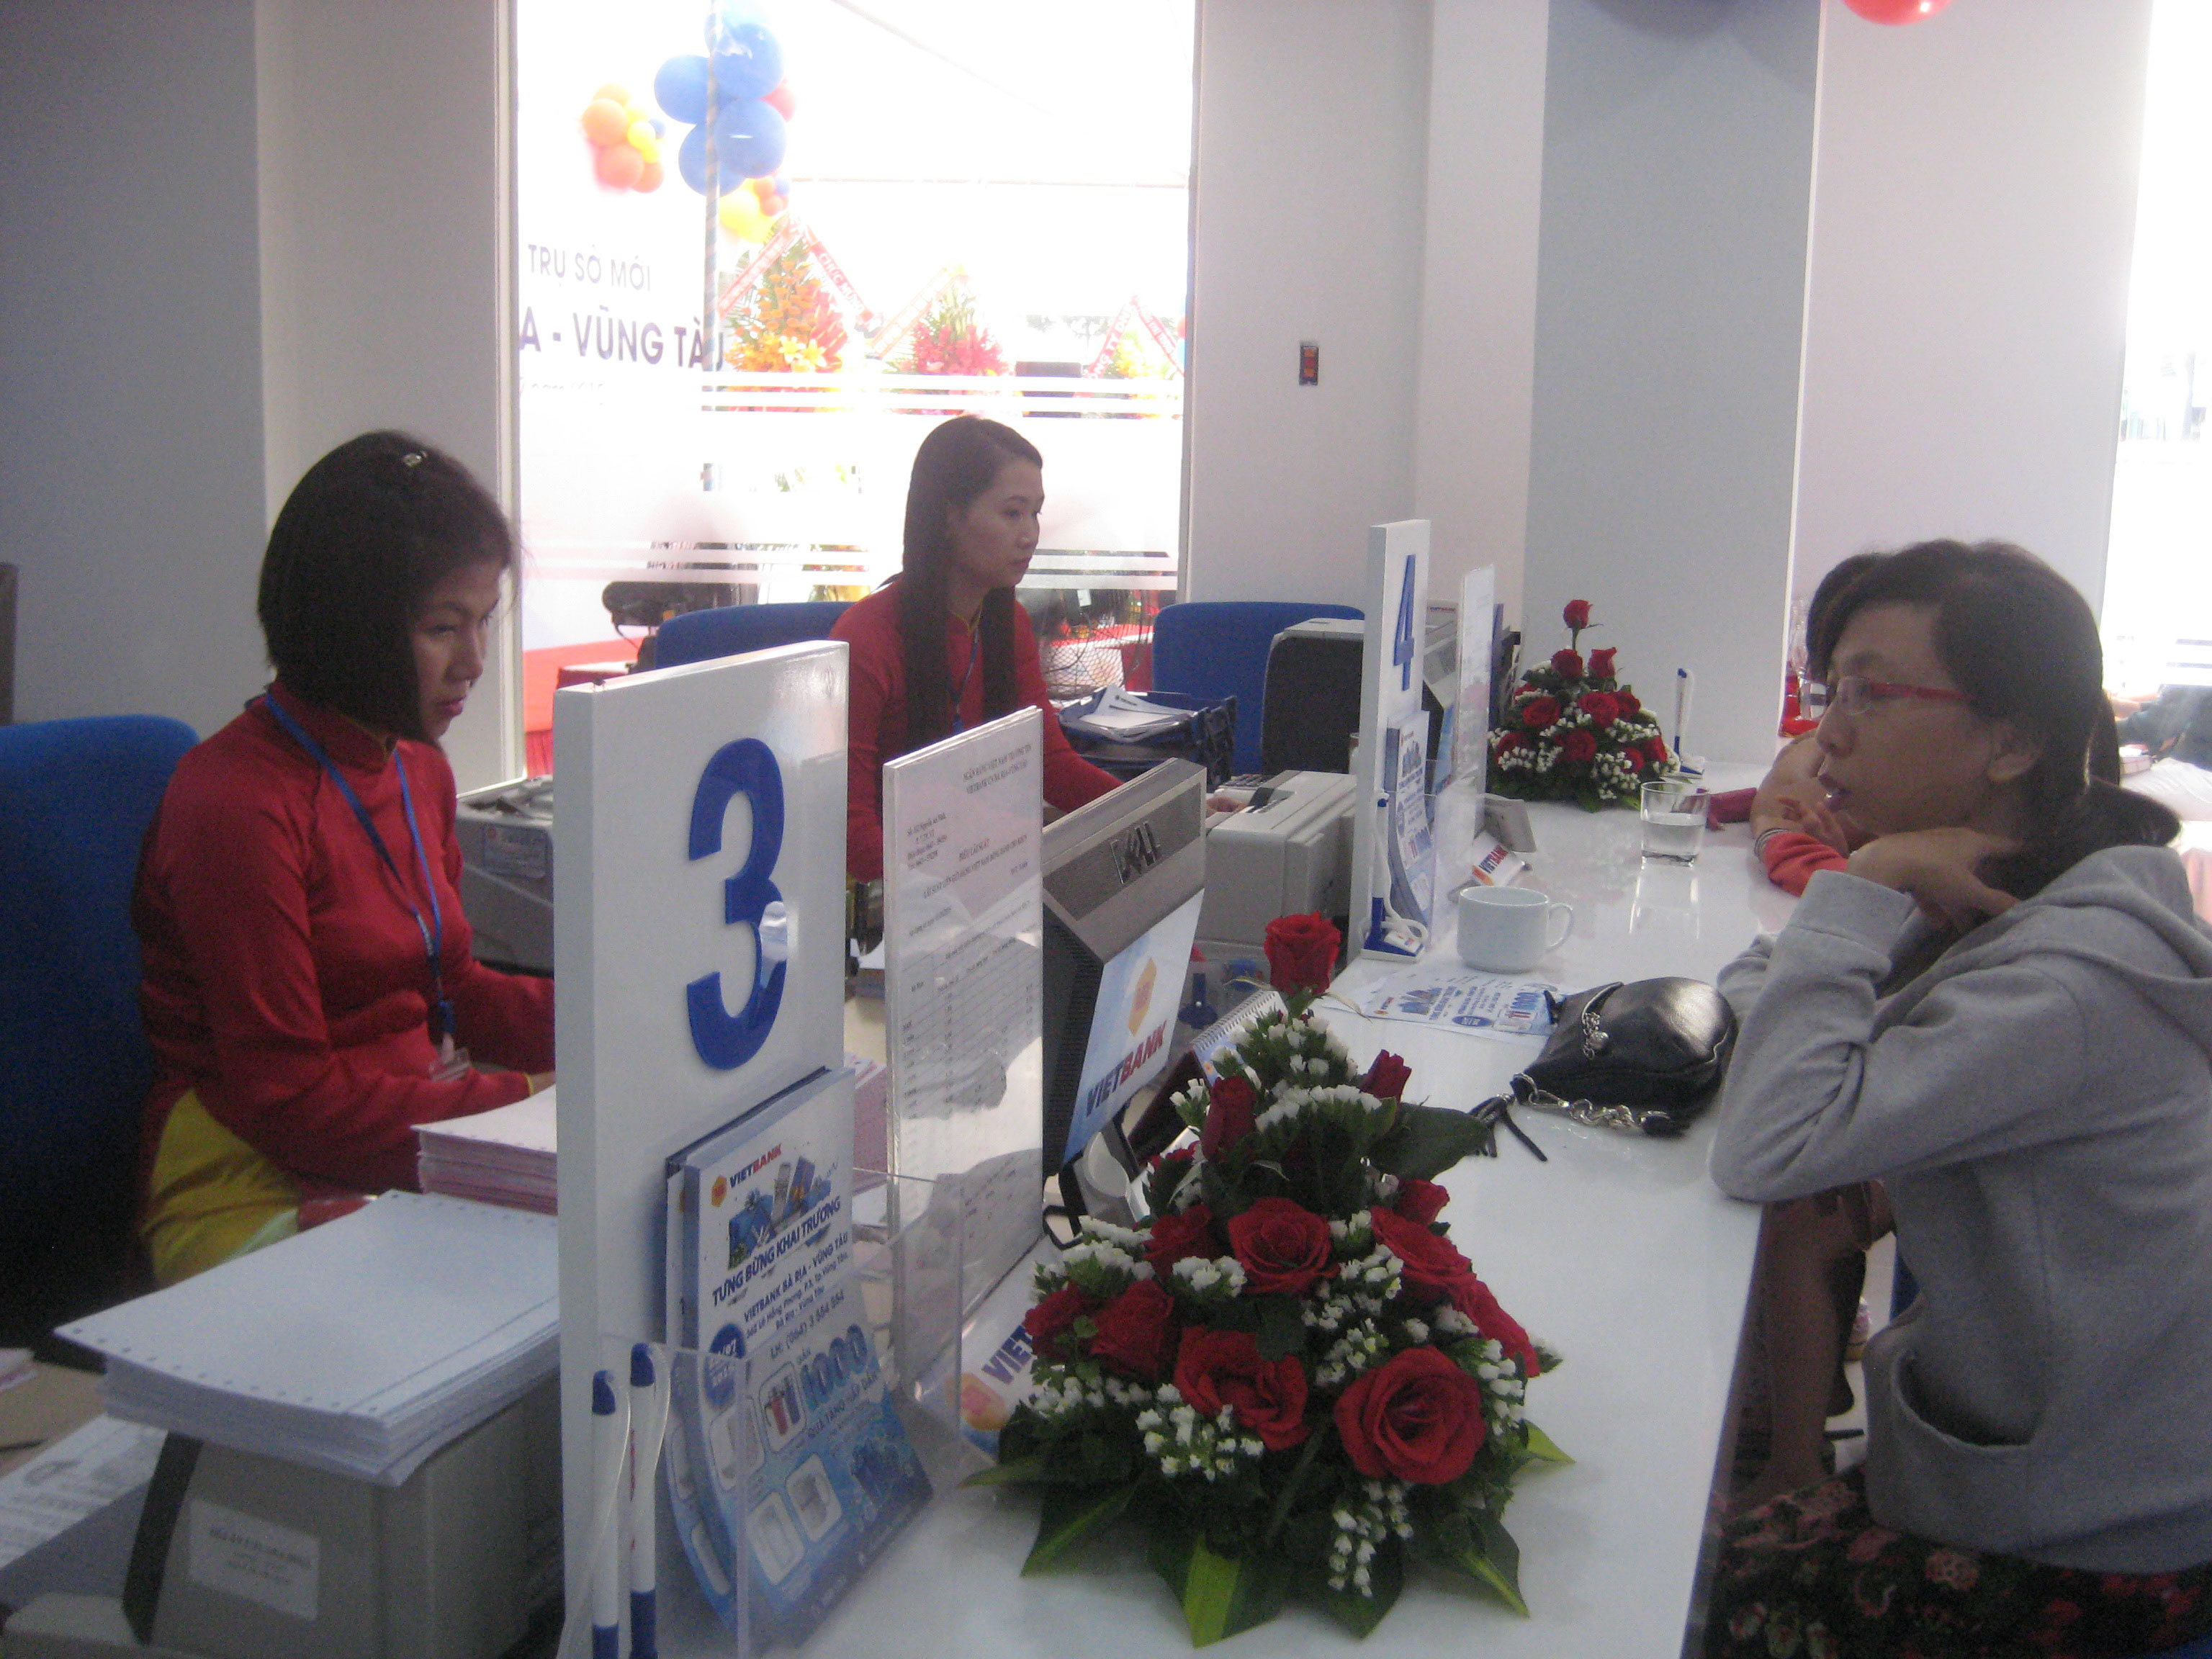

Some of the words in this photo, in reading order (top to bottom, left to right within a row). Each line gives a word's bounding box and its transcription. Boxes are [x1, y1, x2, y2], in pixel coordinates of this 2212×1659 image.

[572, 304, 664, 365] VŨNG
[1393, 554, 1417, 691] 4
[687, 737, 788, 1071] 3
[1087, 1020, 1166, 1117] VIETBANK
[730, 1143, 782, 1187] VIETBANK
[776, 1225, 800, 1257] KHAI
